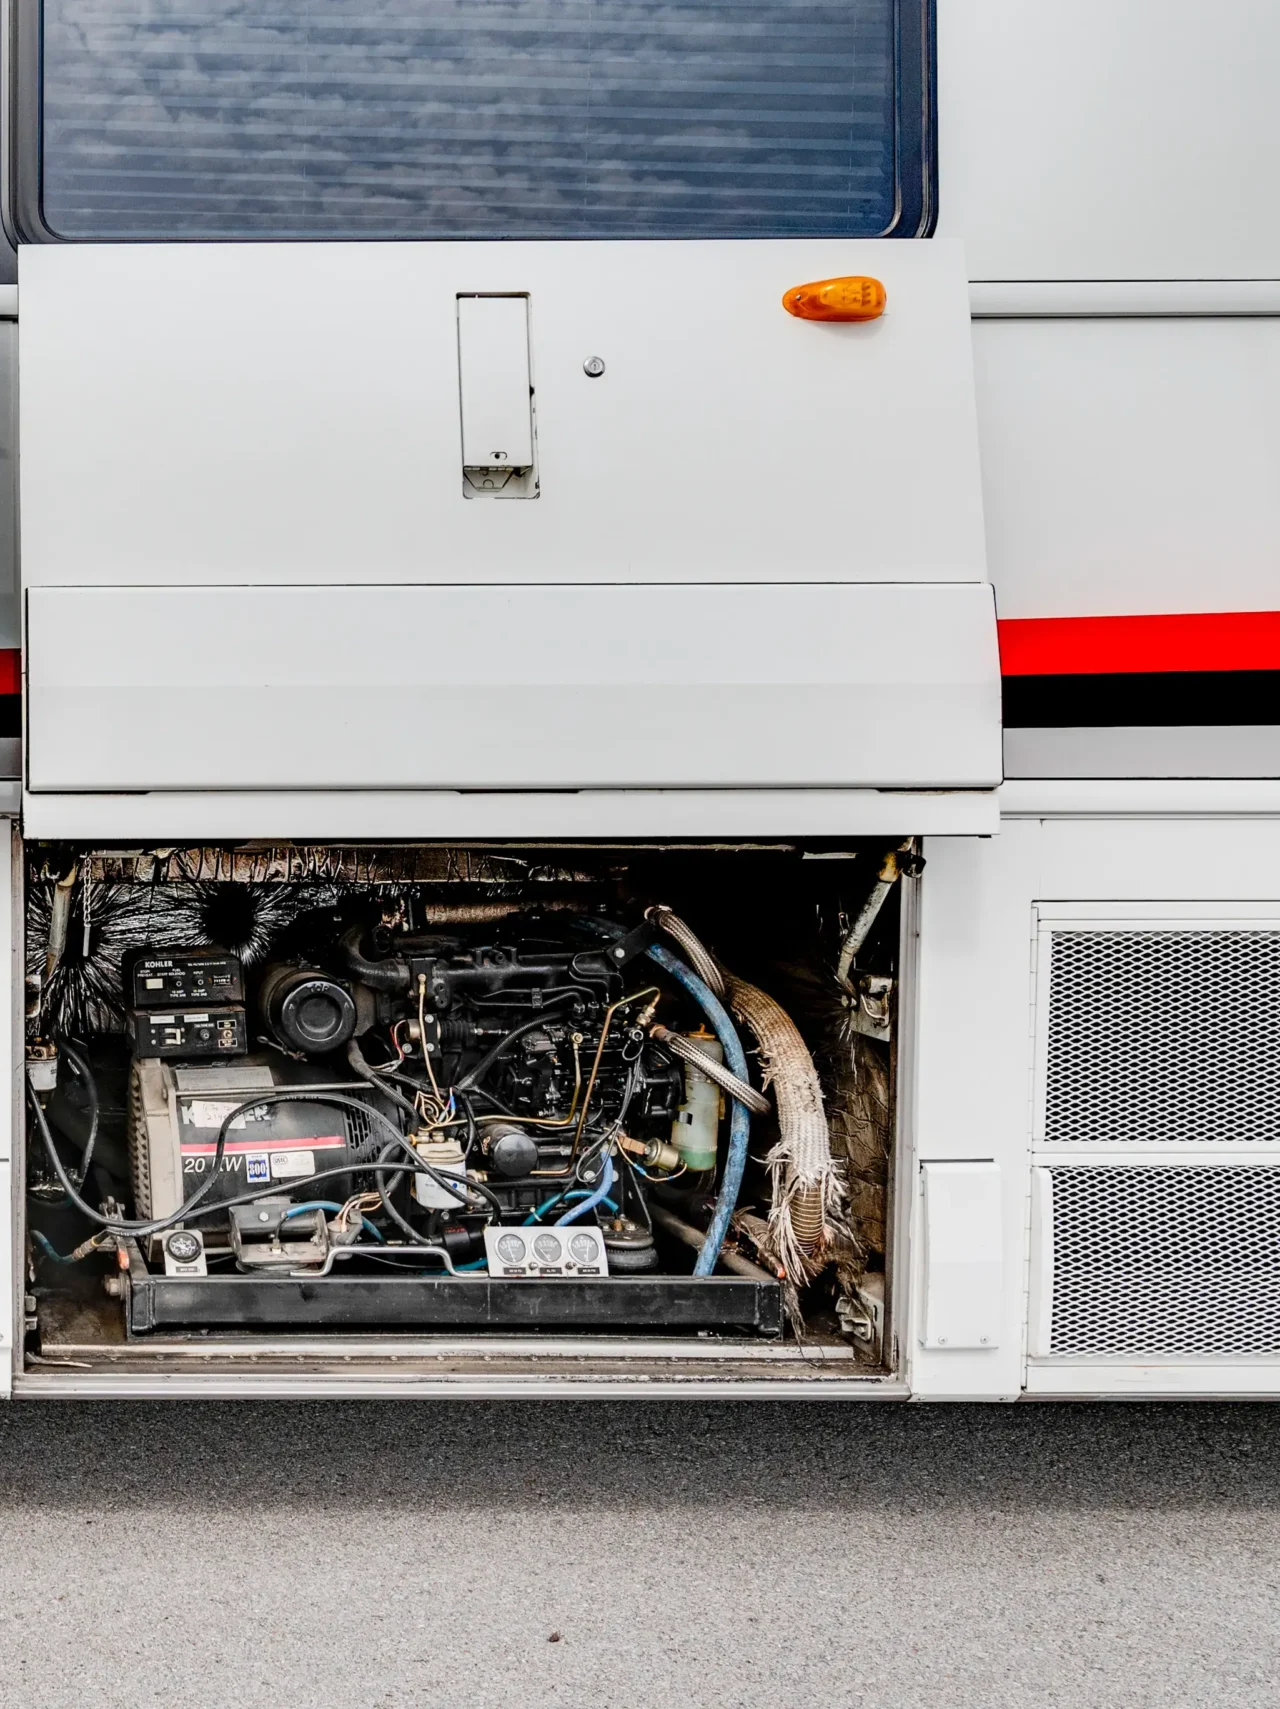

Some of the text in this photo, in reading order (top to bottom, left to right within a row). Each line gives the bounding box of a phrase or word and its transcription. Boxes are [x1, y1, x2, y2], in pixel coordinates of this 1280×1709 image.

[144, 960, 173, 968] KOHLER
[306, 982, 330, 992] TOP
[181, 1103, 272, 1125] KER
[183, 1157, 206, 1173] 20
[249, 1163, 266, 1175] 800
